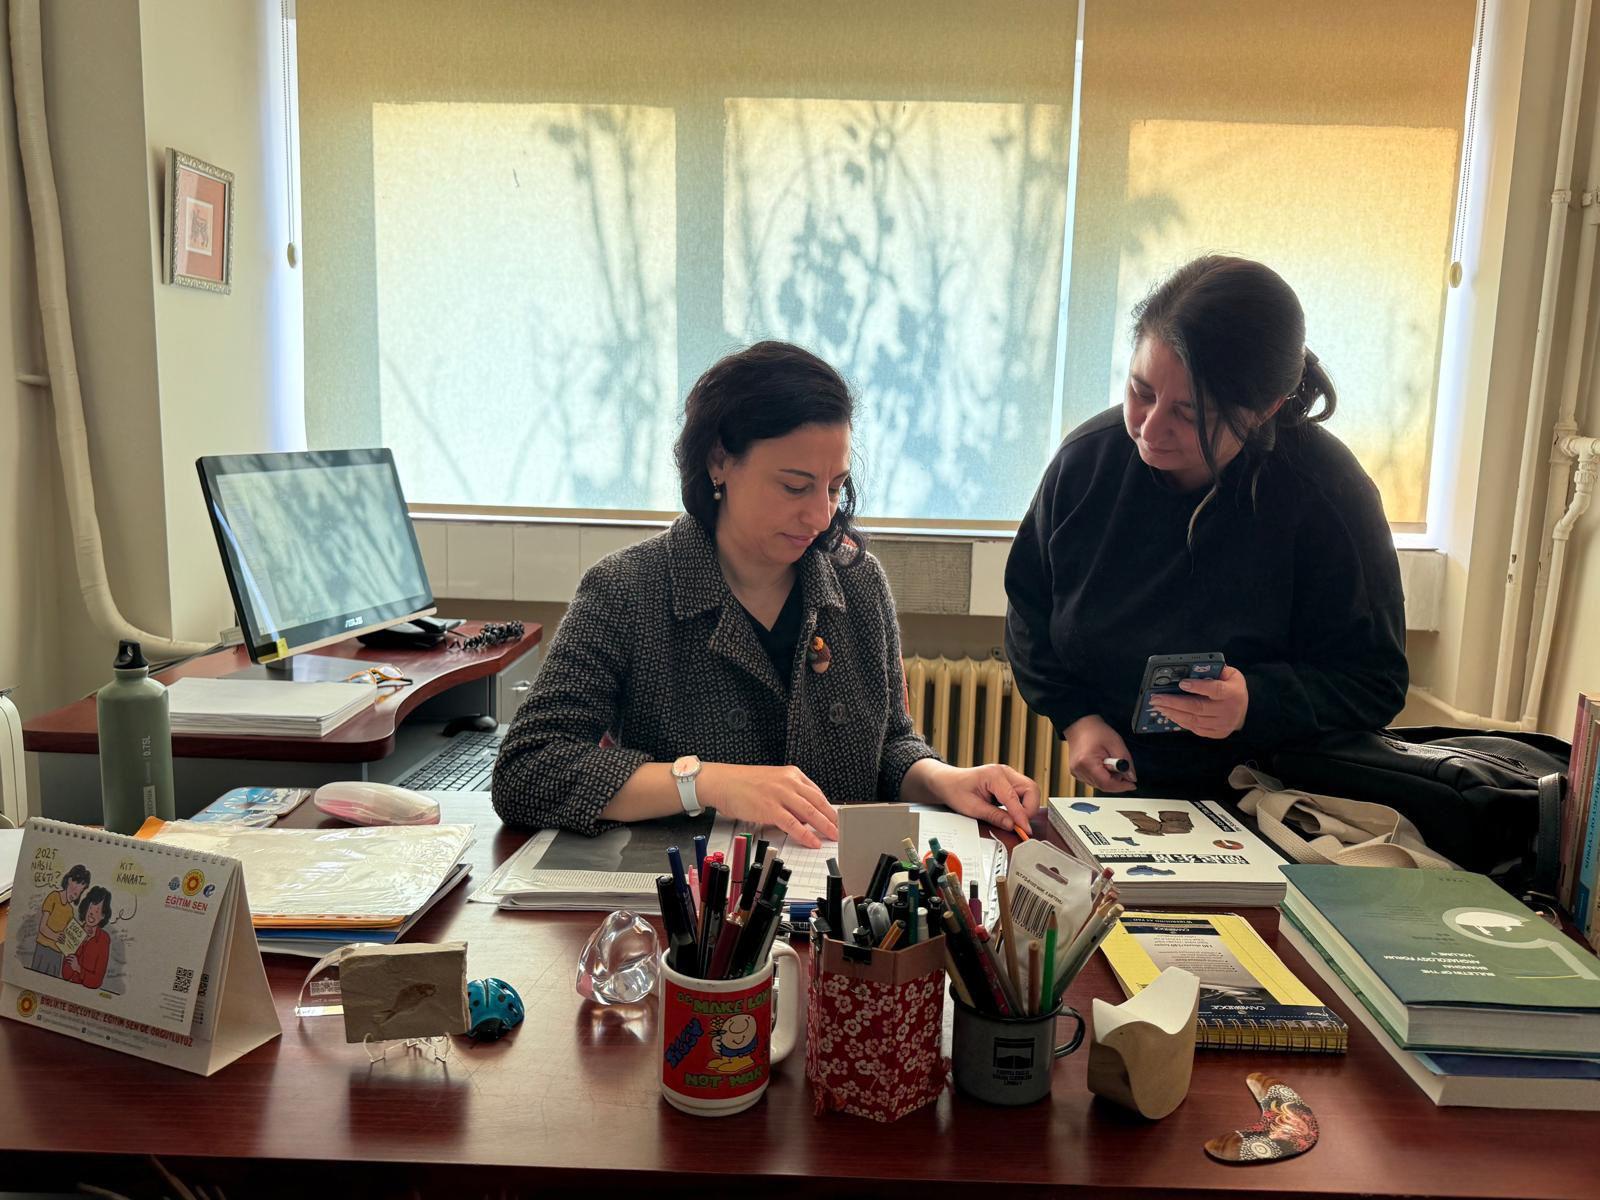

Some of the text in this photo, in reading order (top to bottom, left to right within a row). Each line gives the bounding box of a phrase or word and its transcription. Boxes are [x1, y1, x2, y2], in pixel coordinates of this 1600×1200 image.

[344, 615, 364, 628] ASUS
[191, 901, 208, 912] SEN
[684, 1072, 722, 1089] NOT
